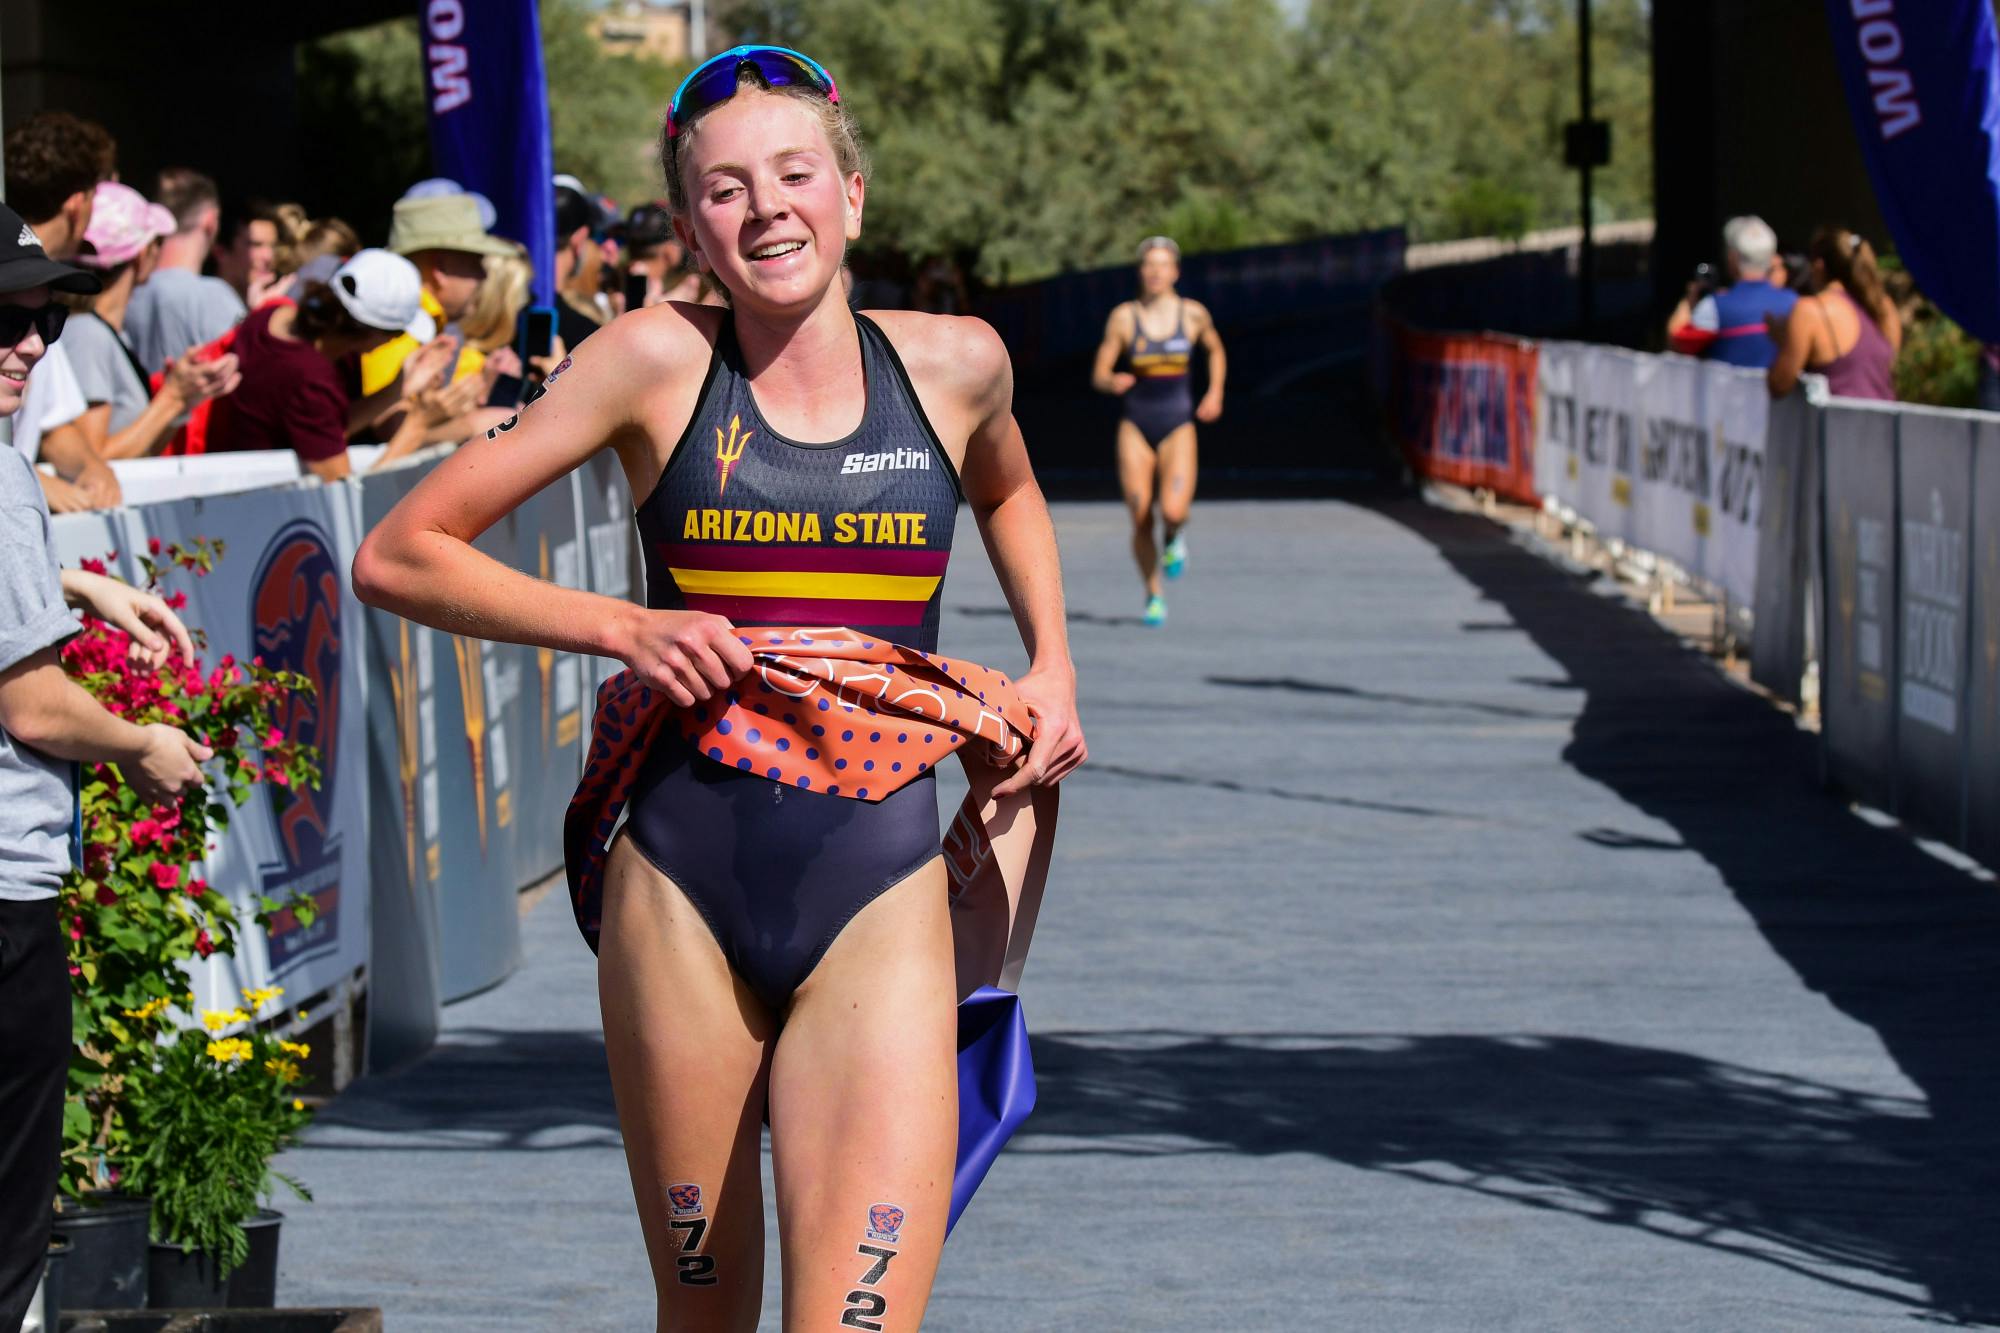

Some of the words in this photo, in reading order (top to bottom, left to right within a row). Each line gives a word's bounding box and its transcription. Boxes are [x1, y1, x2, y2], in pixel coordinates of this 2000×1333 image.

[840, 447, 930, 475] Santini
[683, 508, 822, 542] ARIZONA
[834, 512, 927, 545] STATE
